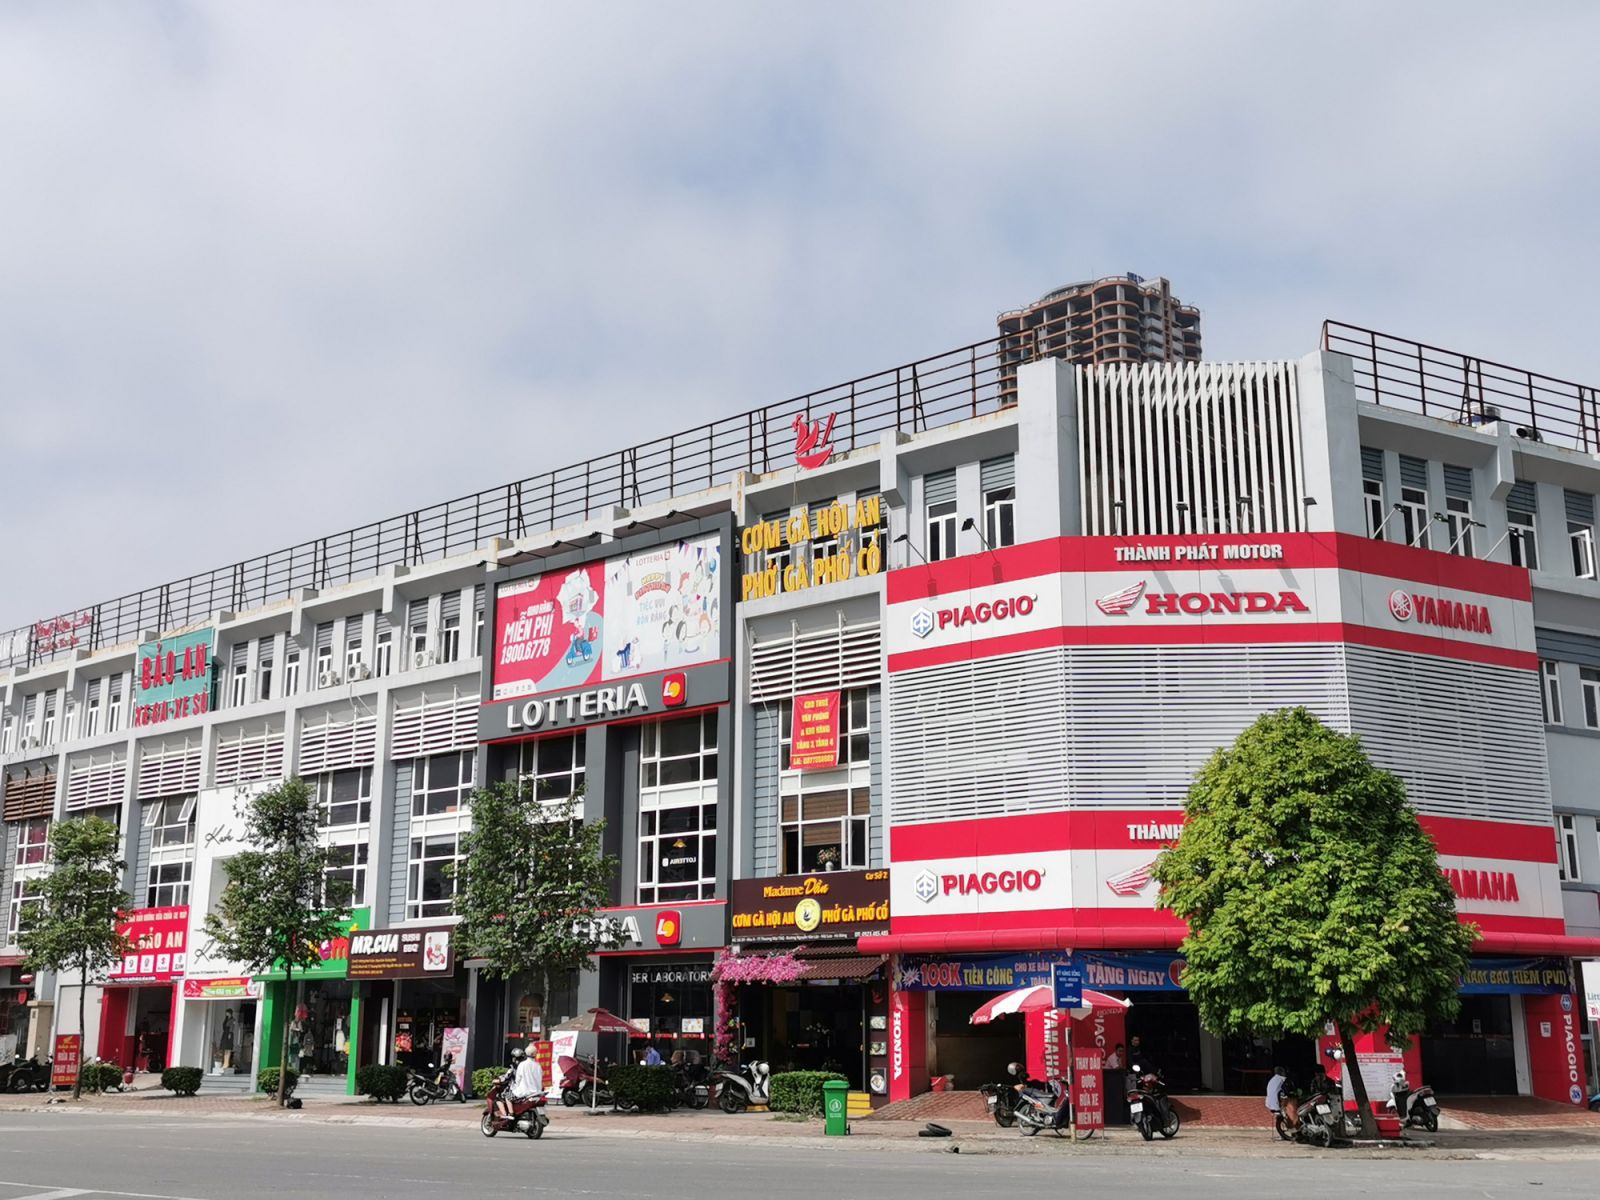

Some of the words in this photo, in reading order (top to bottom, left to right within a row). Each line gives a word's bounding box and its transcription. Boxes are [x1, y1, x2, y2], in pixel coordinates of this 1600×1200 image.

[742, 518, 781, 555] CƠM
[786, 507, 812, 544] GÀ
[816, 500, 849, 539] HỘI
[855, 496, 880, 529] AN
[742, 559, 778, 601] PHỞ
[783, 555, 809, 592] GÀ
[814, 539, 850, 586] PHỐ
[857, 528, 880, 577] CỔ
[1114, 543, 1170, 561] THÀNH
[1175, 543, 1218, 560] PHÁT
[1223, 544, 1283, 559] MOTOR
[937, 596, 1034, 630] PIAGGIO
[1145, 592, 1309, 614] HONDA
[1411, 594, 1492, 634] YAMAHA
[503, 612, 532, 644] MIỄN
[500, 637, 551, 665] 1900.6778
[142, 643, 175, 690] BẢO
[182, 643, 206, 680] AN
[507, 683, 648, 729] LOTTERIA
[763, 886, 804, 898] Madame
[942, 869, 1042, 896] PIAGGIO
[1442, 868, 1519, 902] AMAHA
[733, 914, 752, 928] CƠM
[753, 911, 765, 927] GÀ
[766, 910, 780, 928] HỘI
[782, 911, 795, 924] AN
[822, 903, 840, 923] PHỞ
[842, 904, 854, 922] GÀ
[856, 901, 874, 921] PHỐ
[876, 899, 889, 920] CỔ
[165, 931, 183, 948] AN
[351, 934, 399, 955] MR.CUA
[402, 933, 421, 942] SUSHI
[920, 963, 962, 987] 100K
[963, 963, 984, 985] TIỀN
[986, 966, 1014, 985] CÔNG
[1014, 962, 1027, 972] CHO
[1028, 962, 1037, 972] XE
[1086, 960, 1125, 987] TẶNG
[1127, 970, 1166, 985] NGAY
[893, 1011, 903, 1081] HONDA
[1043, 1009, 1060, 1077] YAMAHA
[1563, 1014, 1578, 1082] PIAGGIO
[1076, 1057, 1089, 1070] THAY
[1091, 1093, 1099, 1106] XE
